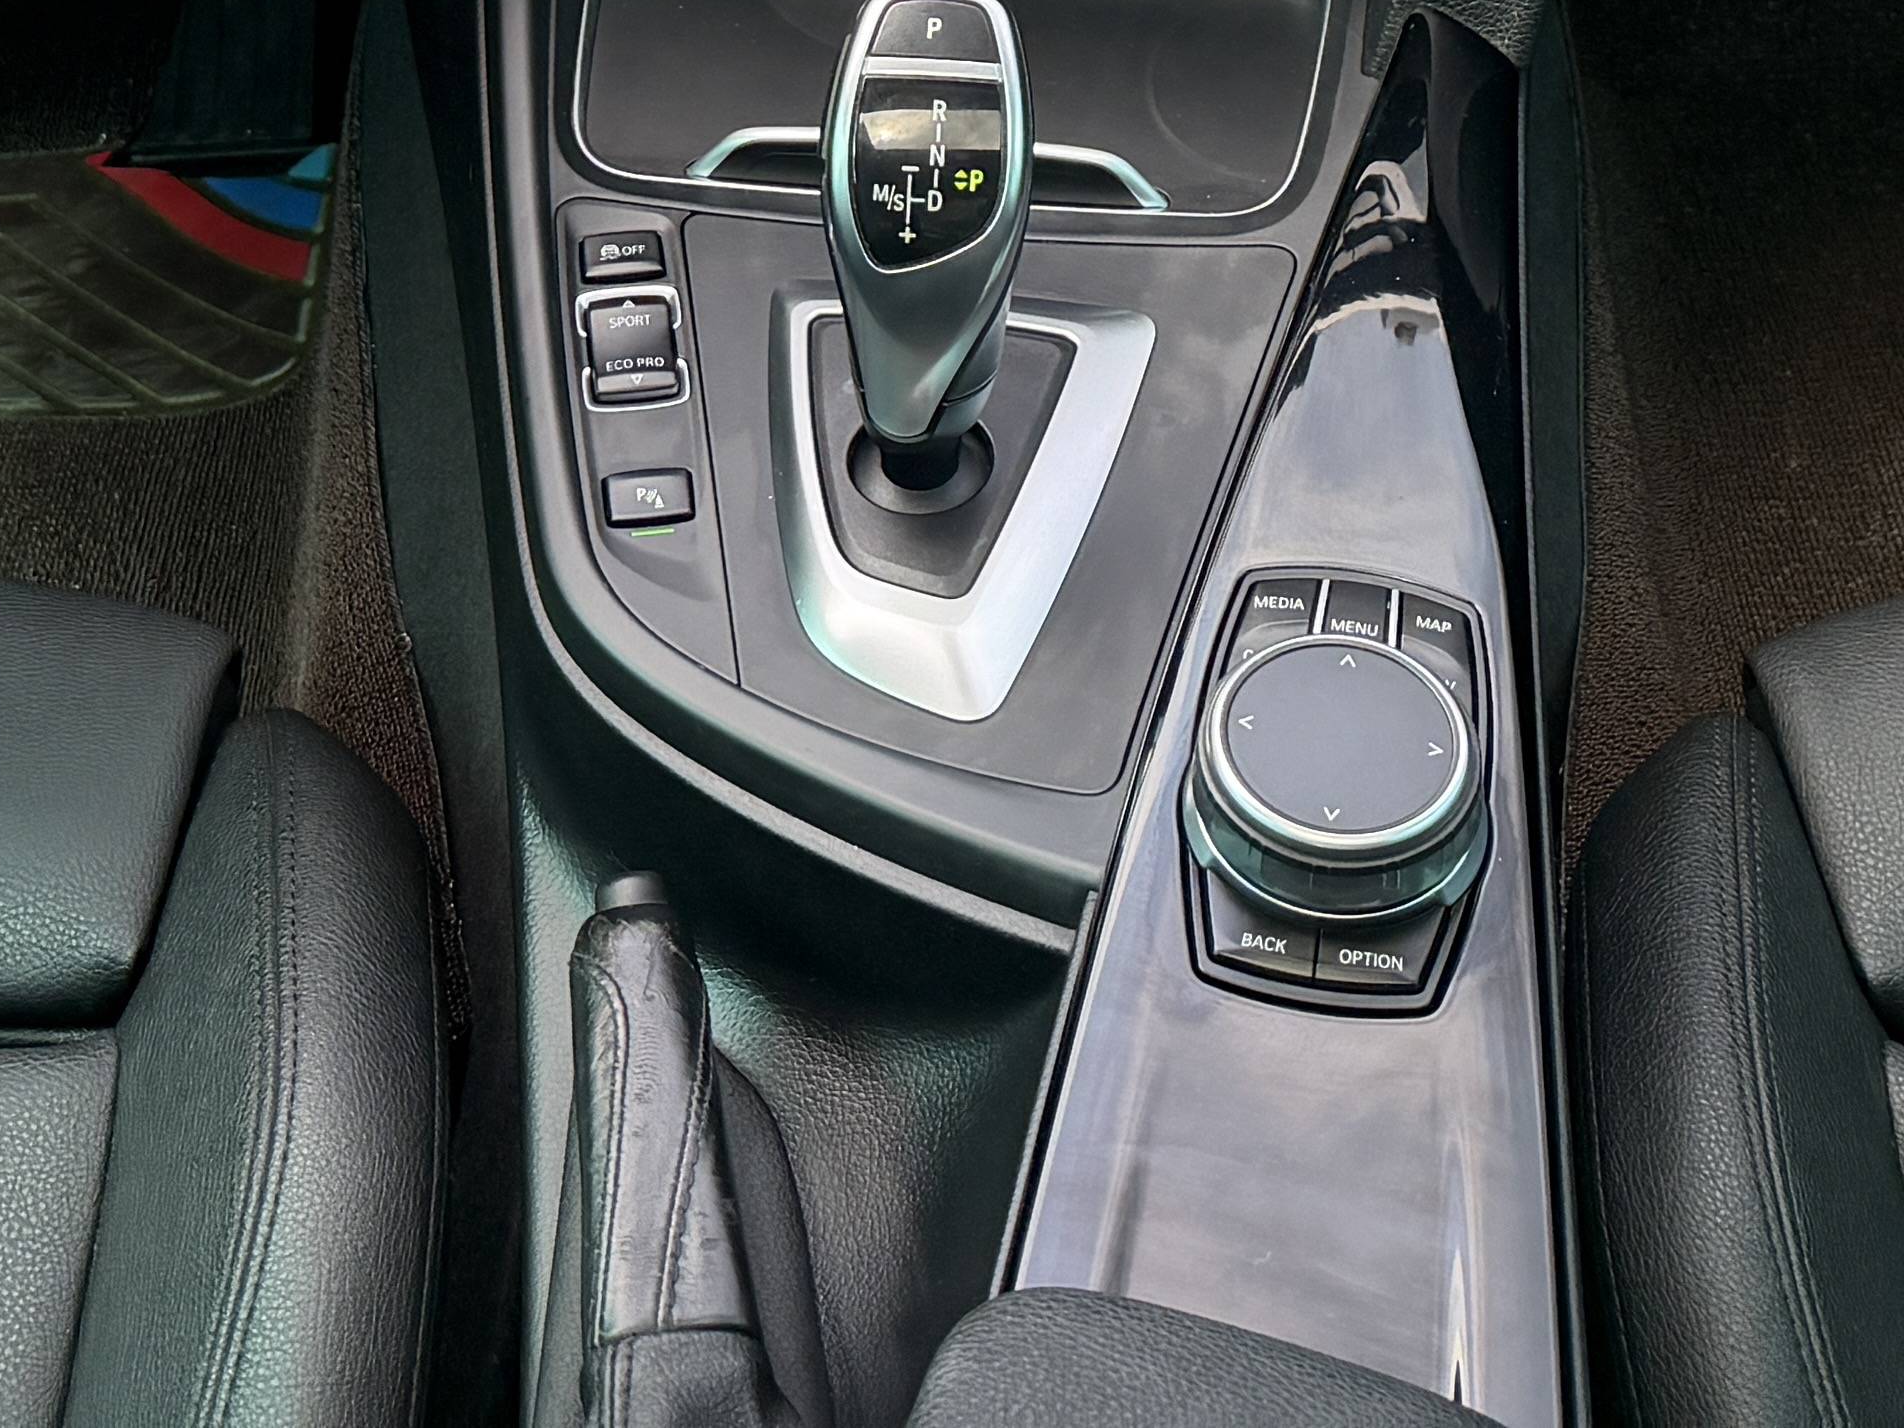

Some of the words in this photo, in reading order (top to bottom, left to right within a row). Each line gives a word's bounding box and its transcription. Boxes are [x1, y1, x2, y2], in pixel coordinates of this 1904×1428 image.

[926, 17, 942, 40] P
[932, 99, 947, 122] R
[929, 144, 945, 167] N
[969, 169, 984, 192] P
[927, 190, 943, 212] D
[622, 244, 645, 256] OFF
[609, 314, 651, 329] SPORT
[606, 358, 634, 372] ECO
[636, 356, 665, 368] PRO
[1253, 594, 1305, 611] MEDIA
[1330, 617, 1379, 637] MENU
[1415, 614, 1453, 633] MAP
[1240, 931, 1288, 954] BACK
[1338, 948, 1405, 972] OPTION
